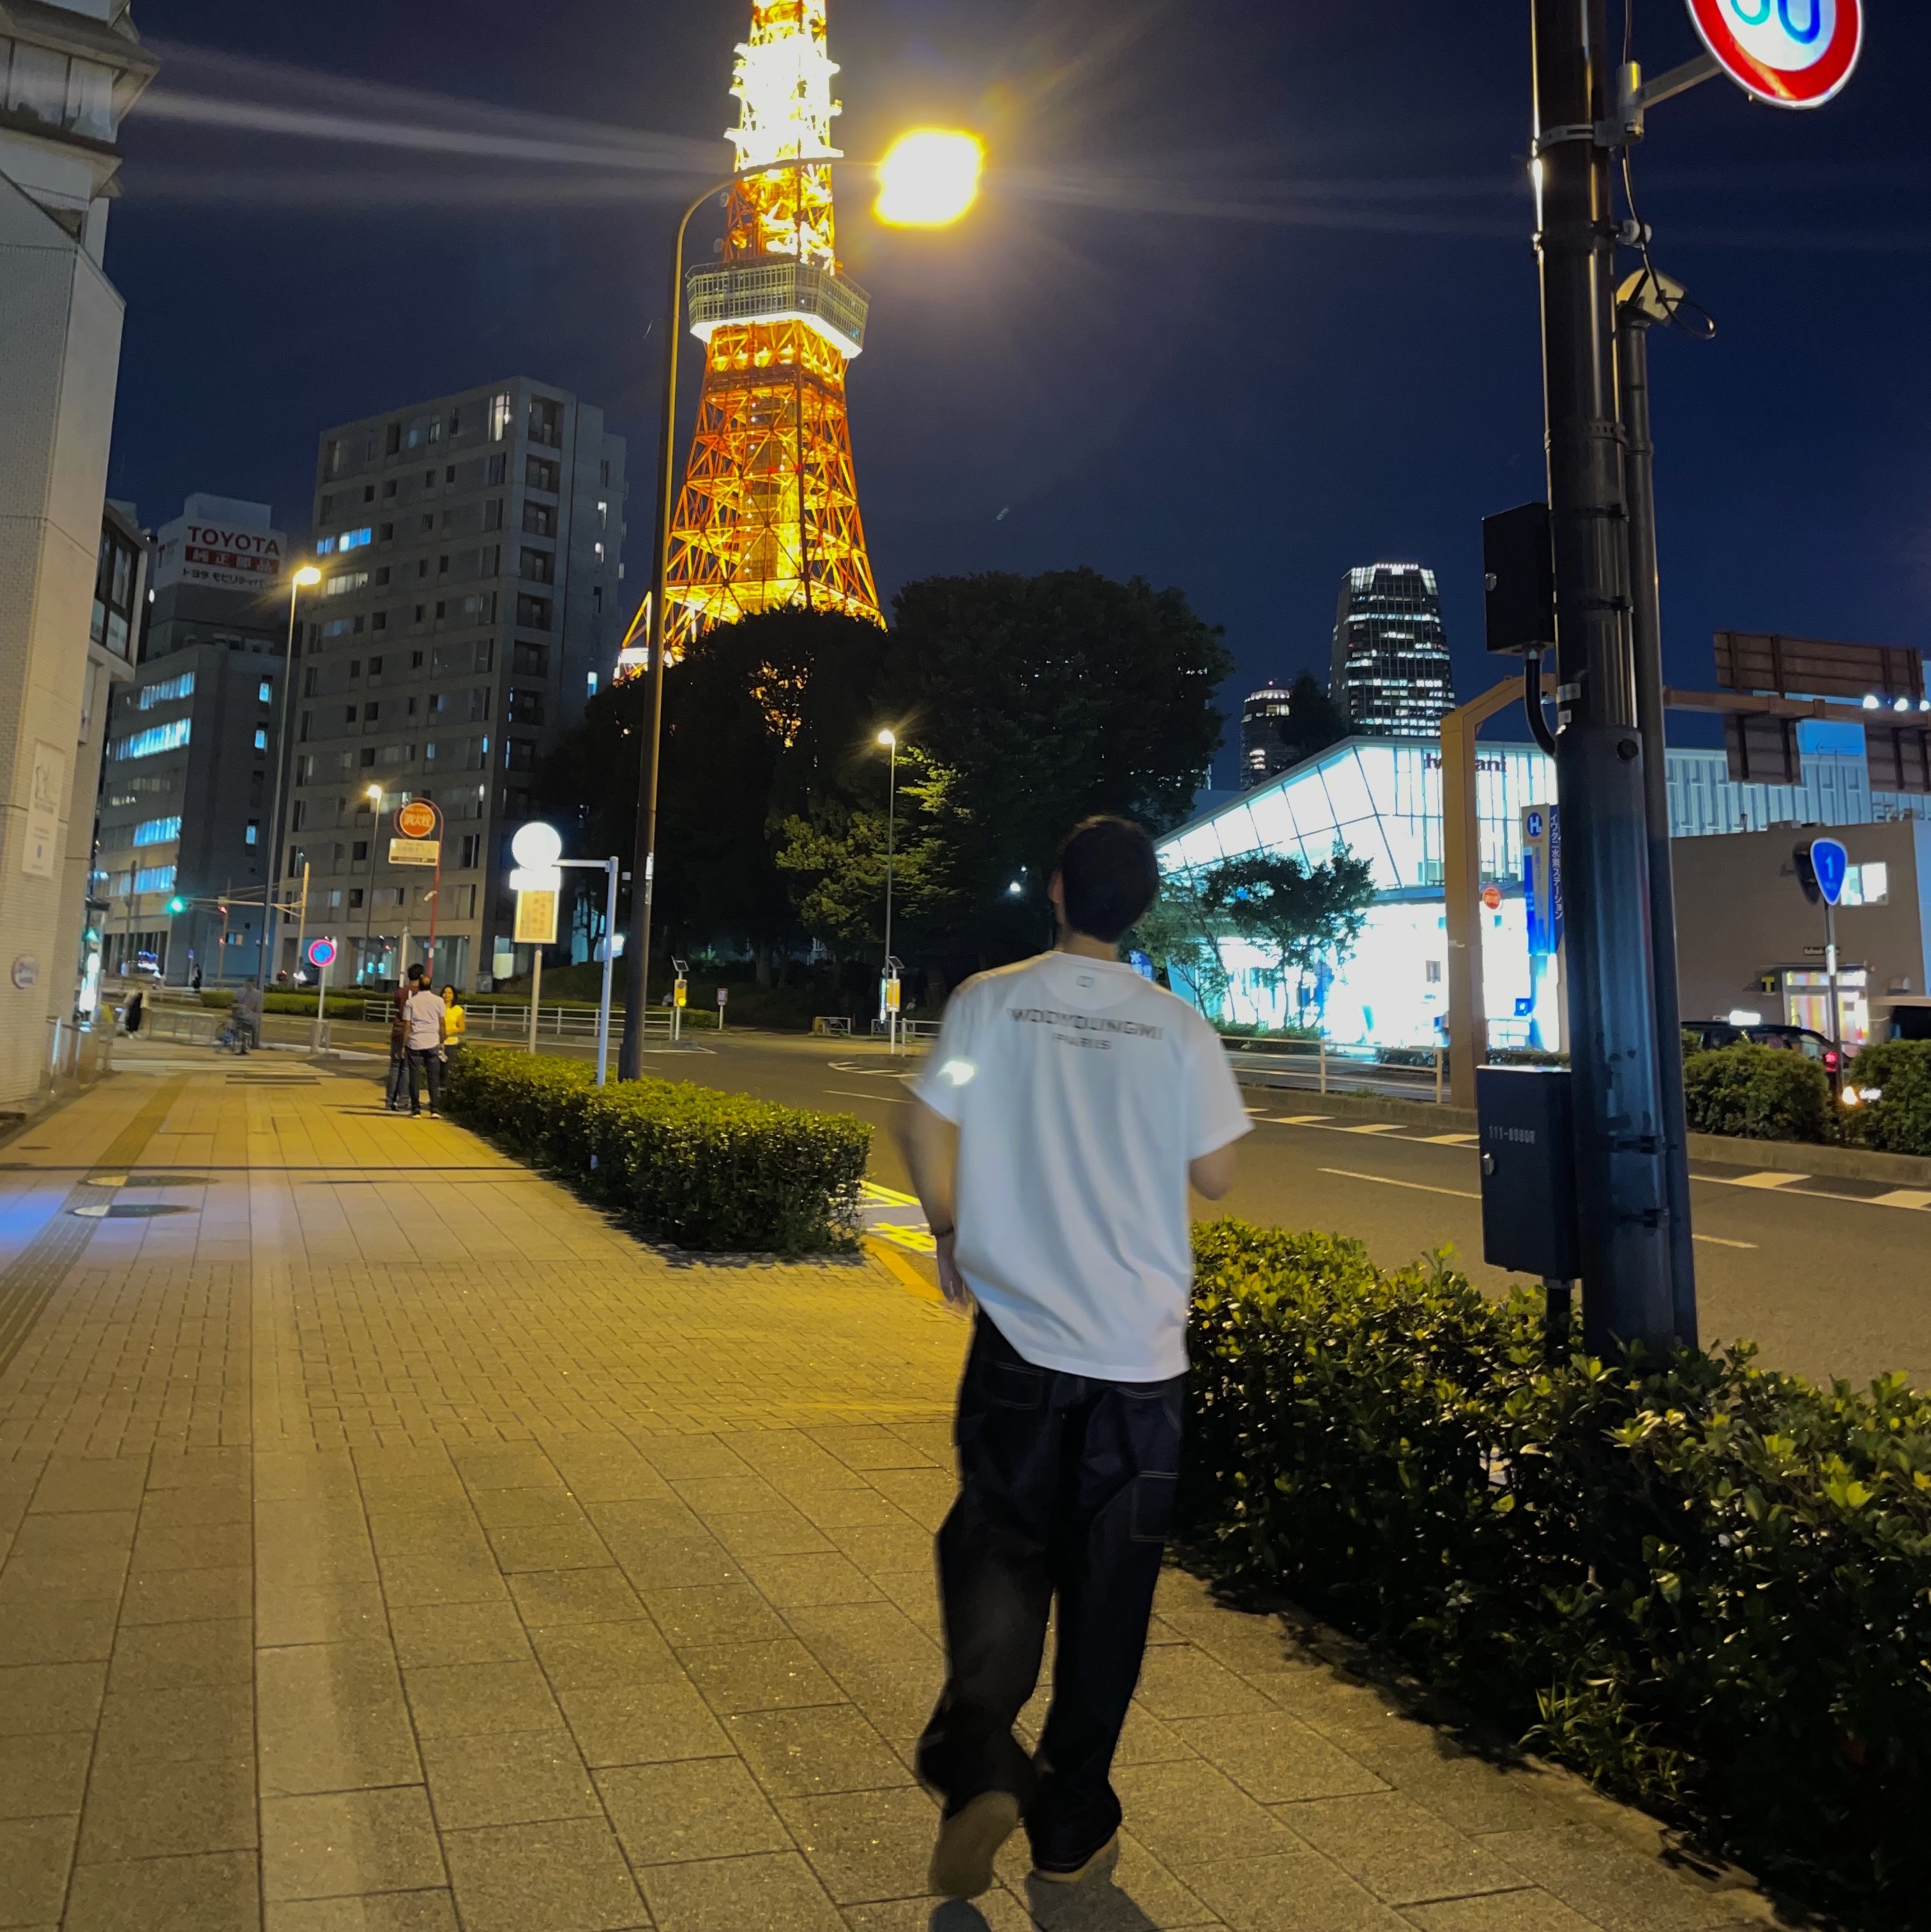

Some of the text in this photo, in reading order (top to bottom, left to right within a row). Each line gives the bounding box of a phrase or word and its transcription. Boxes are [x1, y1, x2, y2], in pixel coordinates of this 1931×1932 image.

[188, 526, 280, 556] TOYOTA
[1826, 856, 1833, 879] 1
[1007, 1008, 1164, 1040] WOOYOUNGMI
[1052, 1032, 1112, 1050] PARIS
